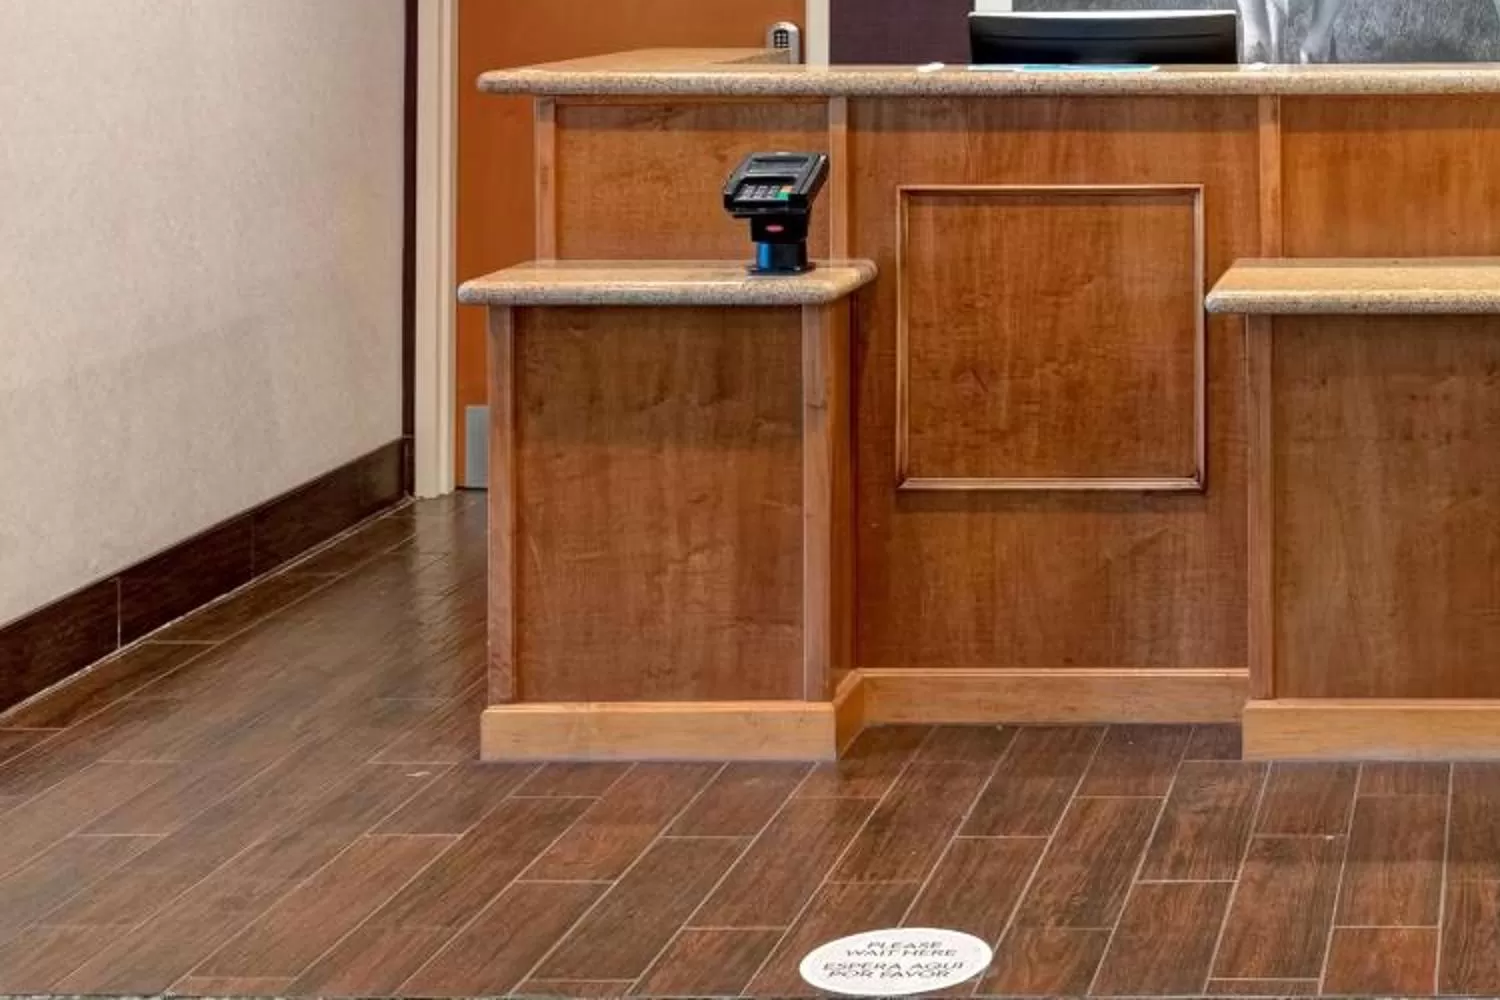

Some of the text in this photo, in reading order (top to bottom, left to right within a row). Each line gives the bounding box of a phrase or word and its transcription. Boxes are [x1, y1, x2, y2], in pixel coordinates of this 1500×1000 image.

[867, 941, 943, 949] PLEASE
[846, 949, 957, 957] WAIT HERE
[823, 961, 901, 970] ESPERA
[829, 970, 950, 978] POR FAVOR
